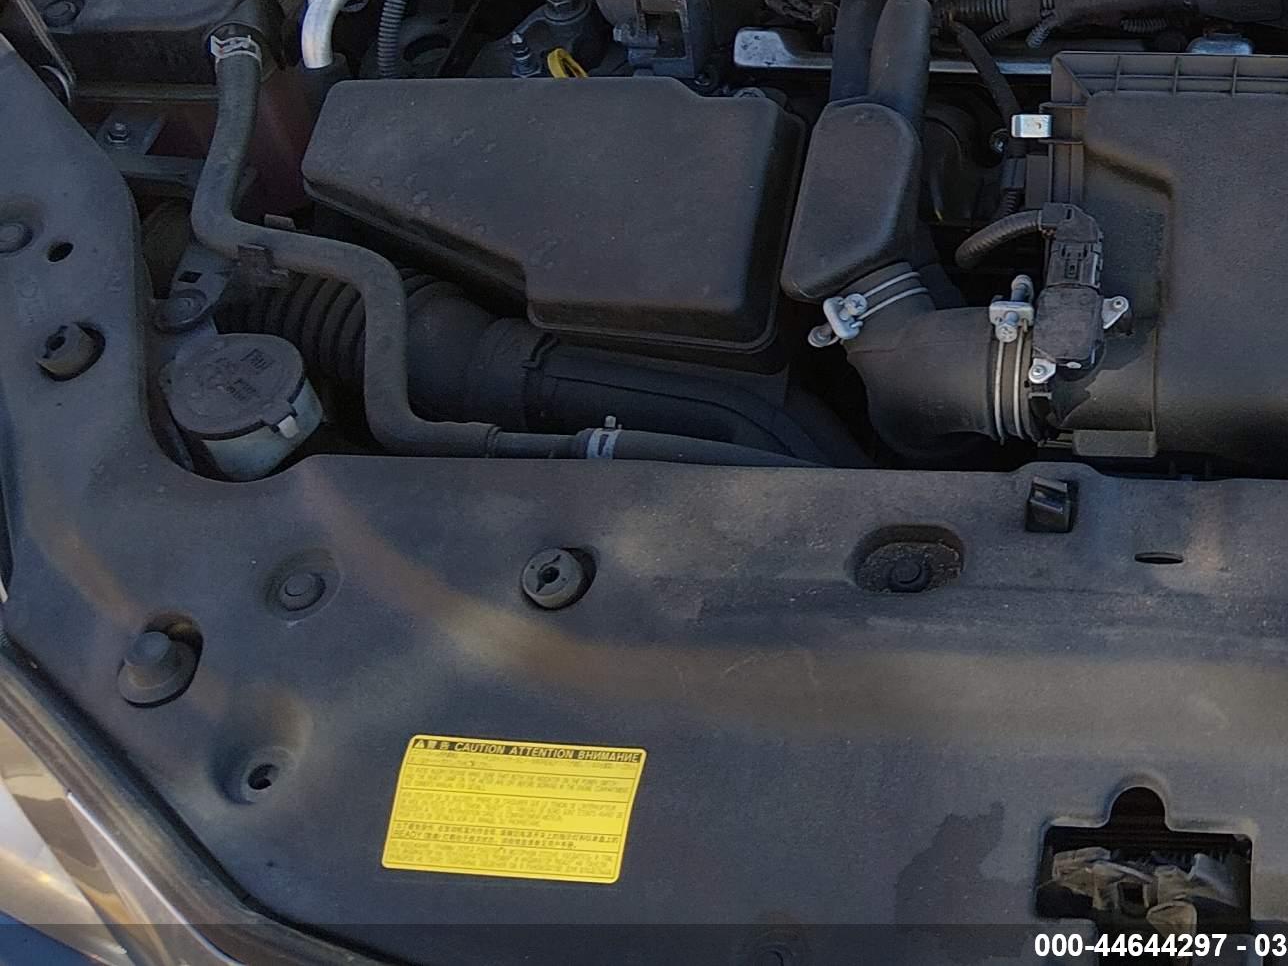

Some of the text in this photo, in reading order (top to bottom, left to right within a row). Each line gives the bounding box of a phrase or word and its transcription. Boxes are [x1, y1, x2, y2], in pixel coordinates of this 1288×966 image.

[454, 742, 506, 754] CAUTION
[509, 745, 575, 759] ATTENTION
[577, 750, 640, 763] ВНИМАНИЕ
